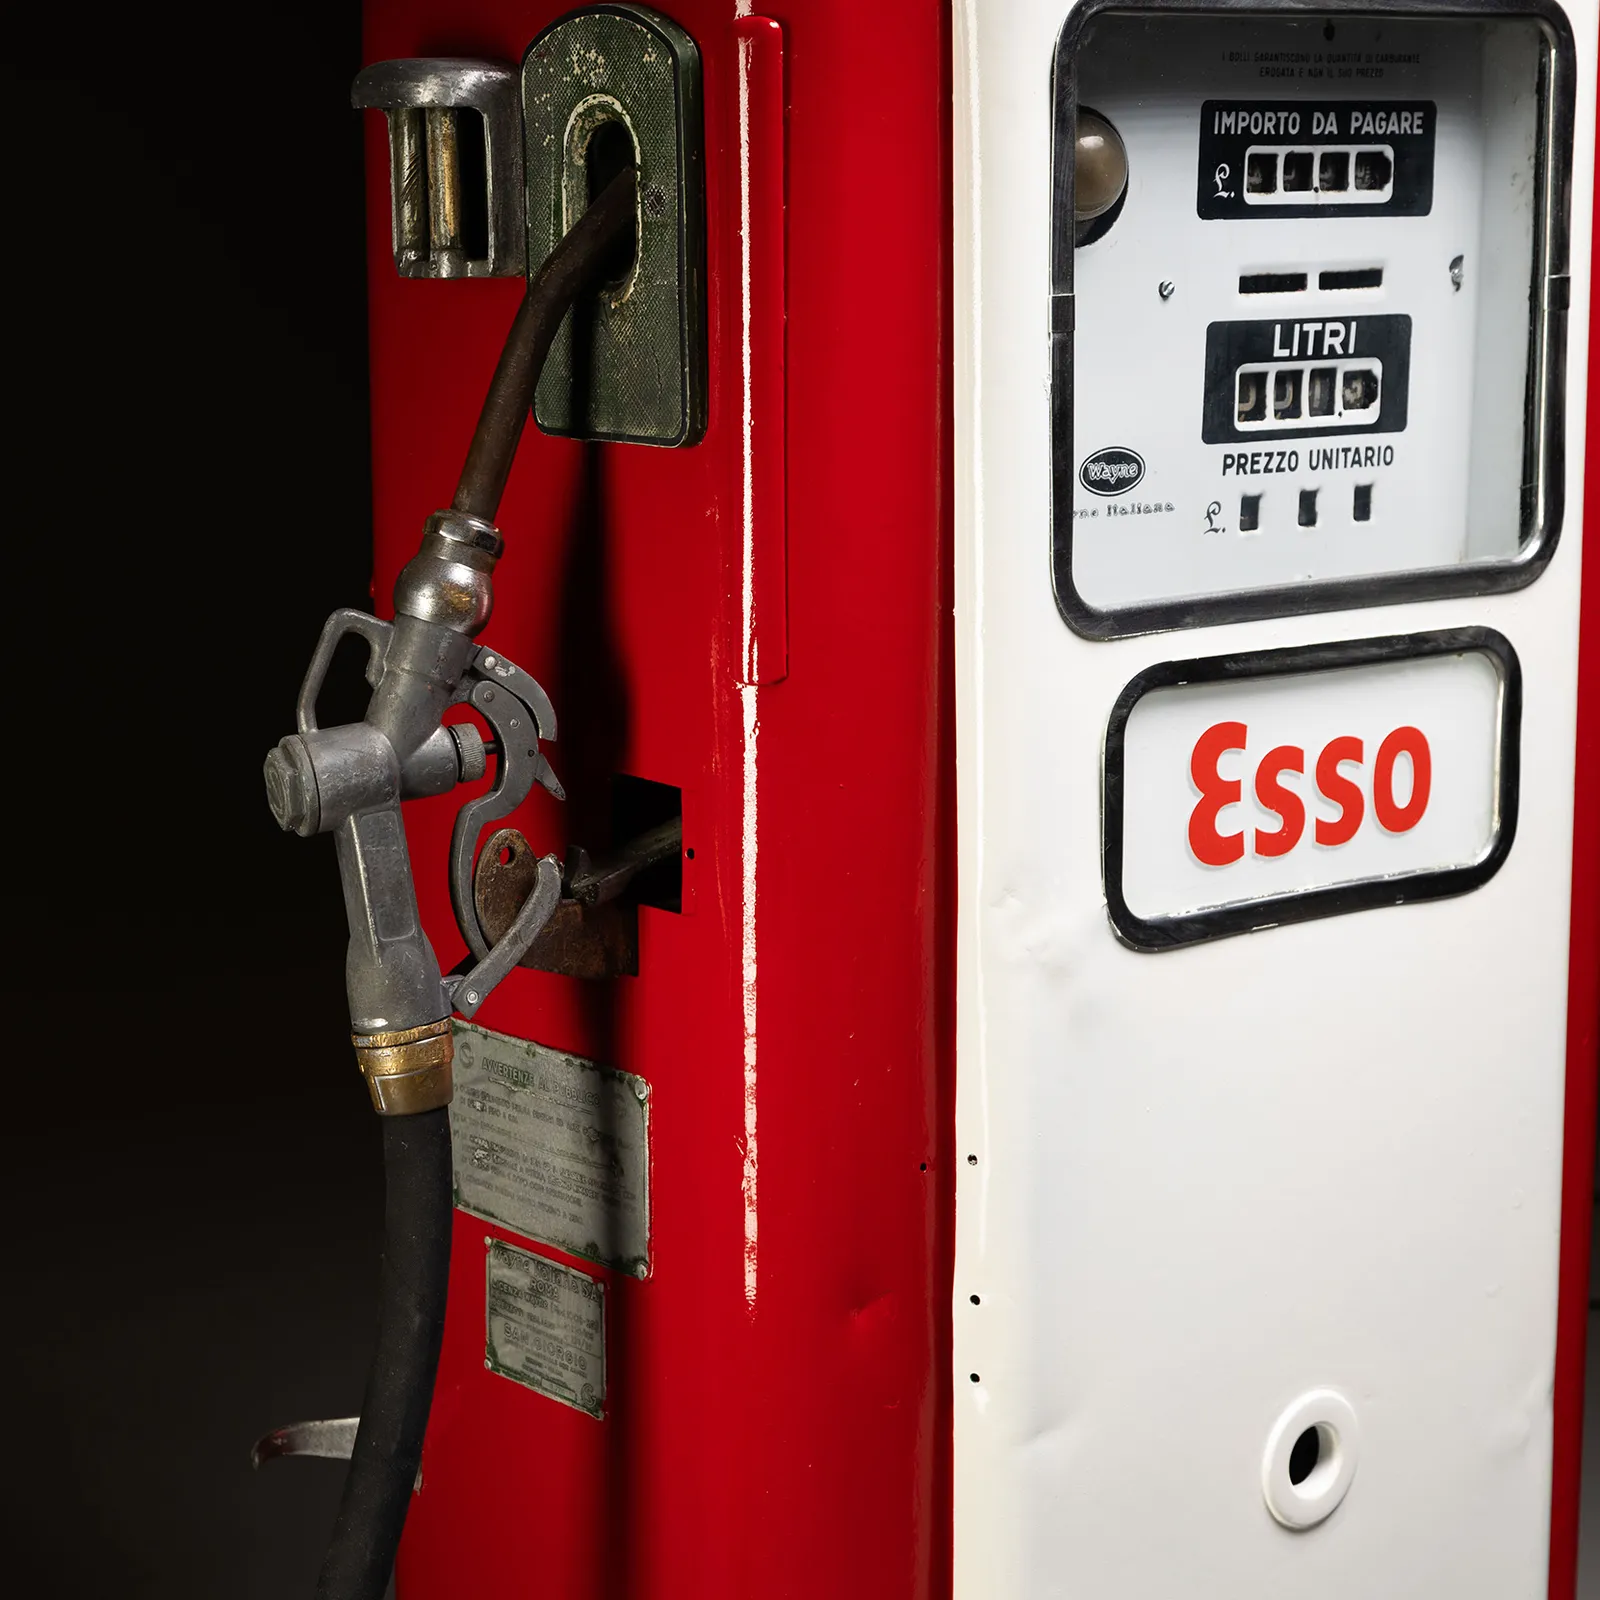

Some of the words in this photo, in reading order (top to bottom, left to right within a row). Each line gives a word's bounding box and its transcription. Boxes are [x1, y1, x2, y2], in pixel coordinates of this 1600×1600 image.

[1213, 111, 1300, 135] IMPORTO
[1312, 111, 1338, 135] DA
[1350, 111, 1424, 135] PAGARE
[1273, 321, 1357, 358] LITRI
[1086, 461, 1139, 485] Wayne
[1222, 450, 1299, 476] PREZZO
[1308, 445, 1394, 471] UNITARIO
[481, 1056, 534, 1087] AVVERTENZE
